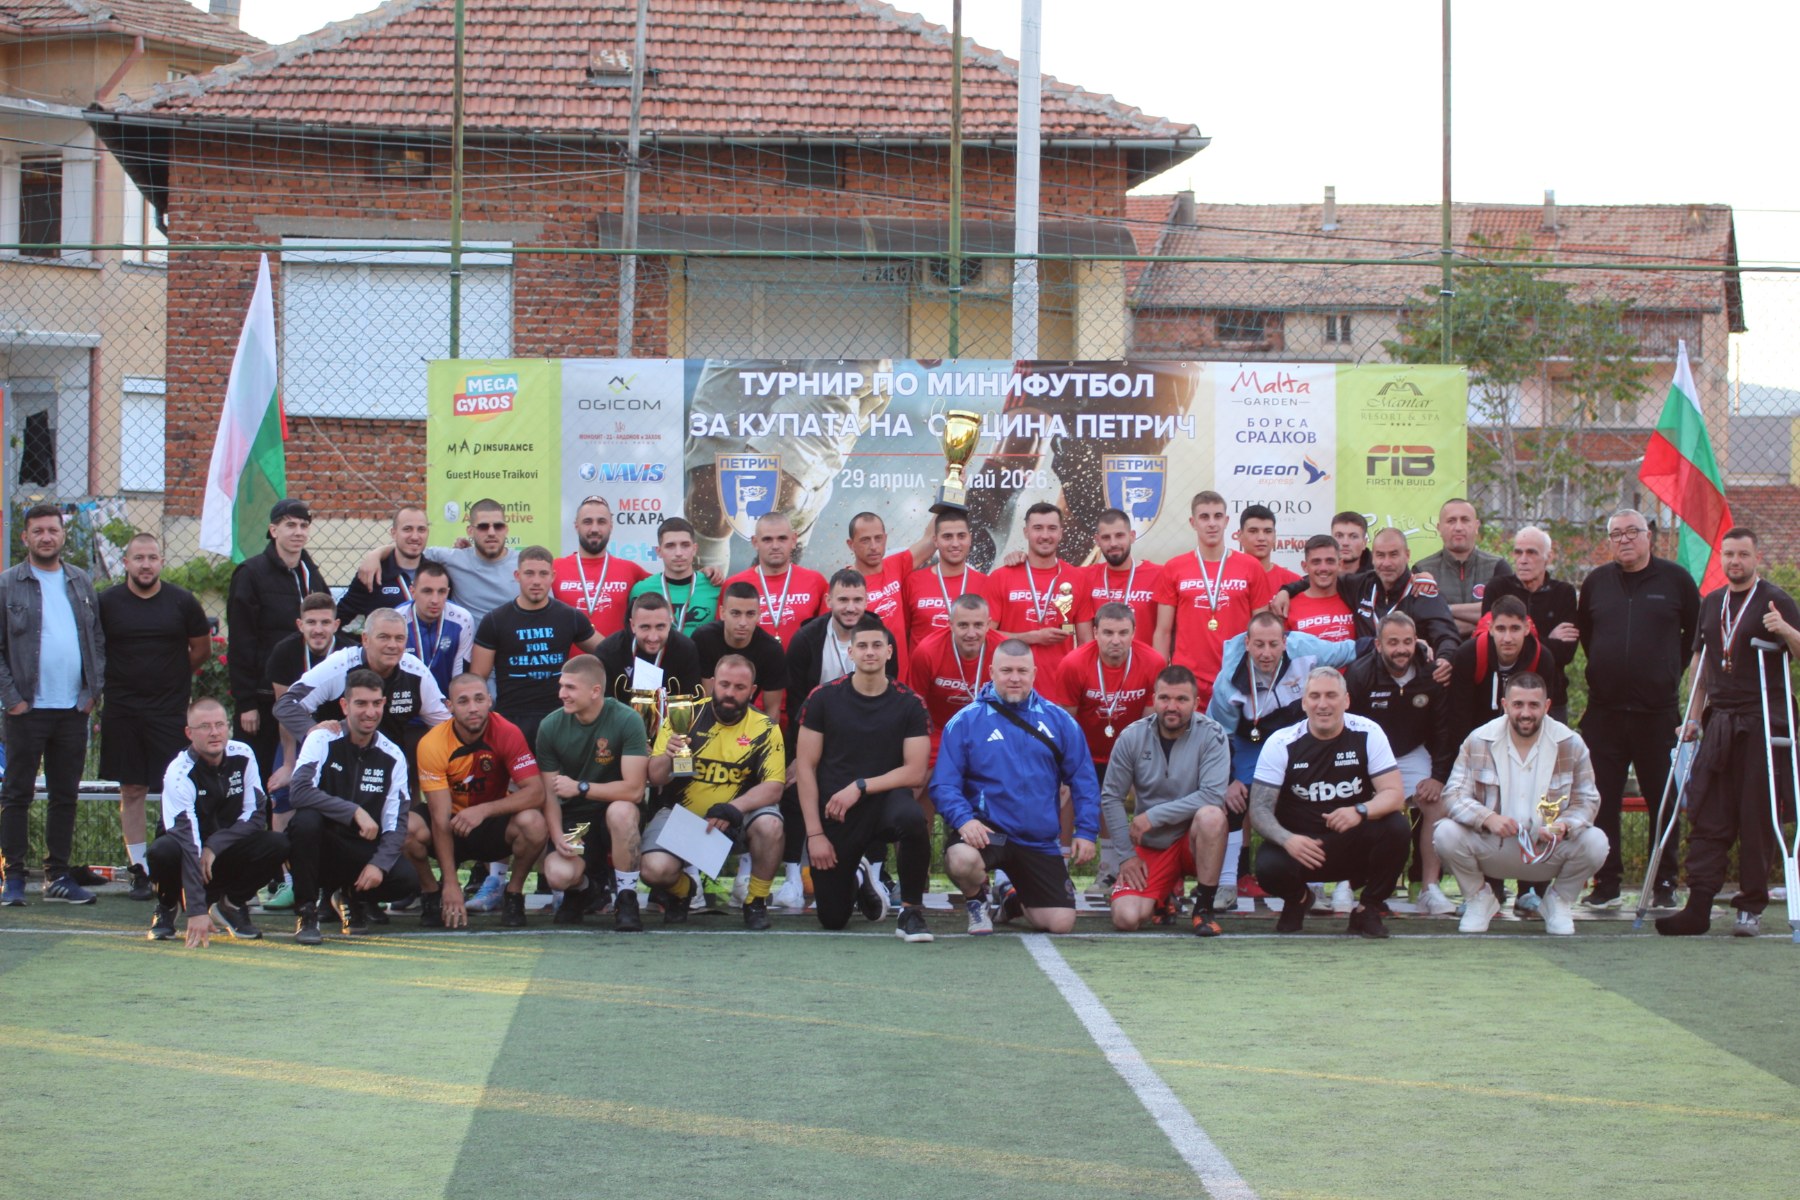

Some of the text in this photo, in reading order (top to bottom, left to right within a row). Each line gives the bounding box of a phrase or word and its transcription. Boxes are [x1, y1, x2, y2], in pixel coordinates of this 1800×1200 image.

[468, 377, 518, 392] MEGA
[740, 372, 1154, 398] ТУРНИР ПО МИНИФУТБОЛ
[1230, 371, 1311, 394] Malta
[578, 399, 662, 411] OGICOM
[1243, 397, 1298, 406] GARDEN
[690, 413, 1195, 441] ЗА КУПАТА НА ОЩИНА ПЕТРИЧ
[1247, 417, 1308, 428] БОРСА
[1235, 430, 1317, 444] СРАДКОВ
[483, 443, 534, 452] INSURANCE
[720, 458, 778, 470] ПЕТРИЧ
[1106, 459, 1164, 471] ПЕТРИЧ
[446, 470, 539, 480] Guest House Traikovi
[841, 469, 864, 489] 29
[869, 469, 925, 492] април
[1000, 469, 1047, 489] 2026
[1366, 478, 1391, 486] FIRST
[1406, 479, 1436, 487] BUILD
[1297, 614, 1354, 630] BPOS AUT
[516, 627, 554, 640] TIME
[526, 642, 549, 652] FOR
[509, 653, 563, 666] CHANGE
[1291, 776, 1363, 802] efbet
